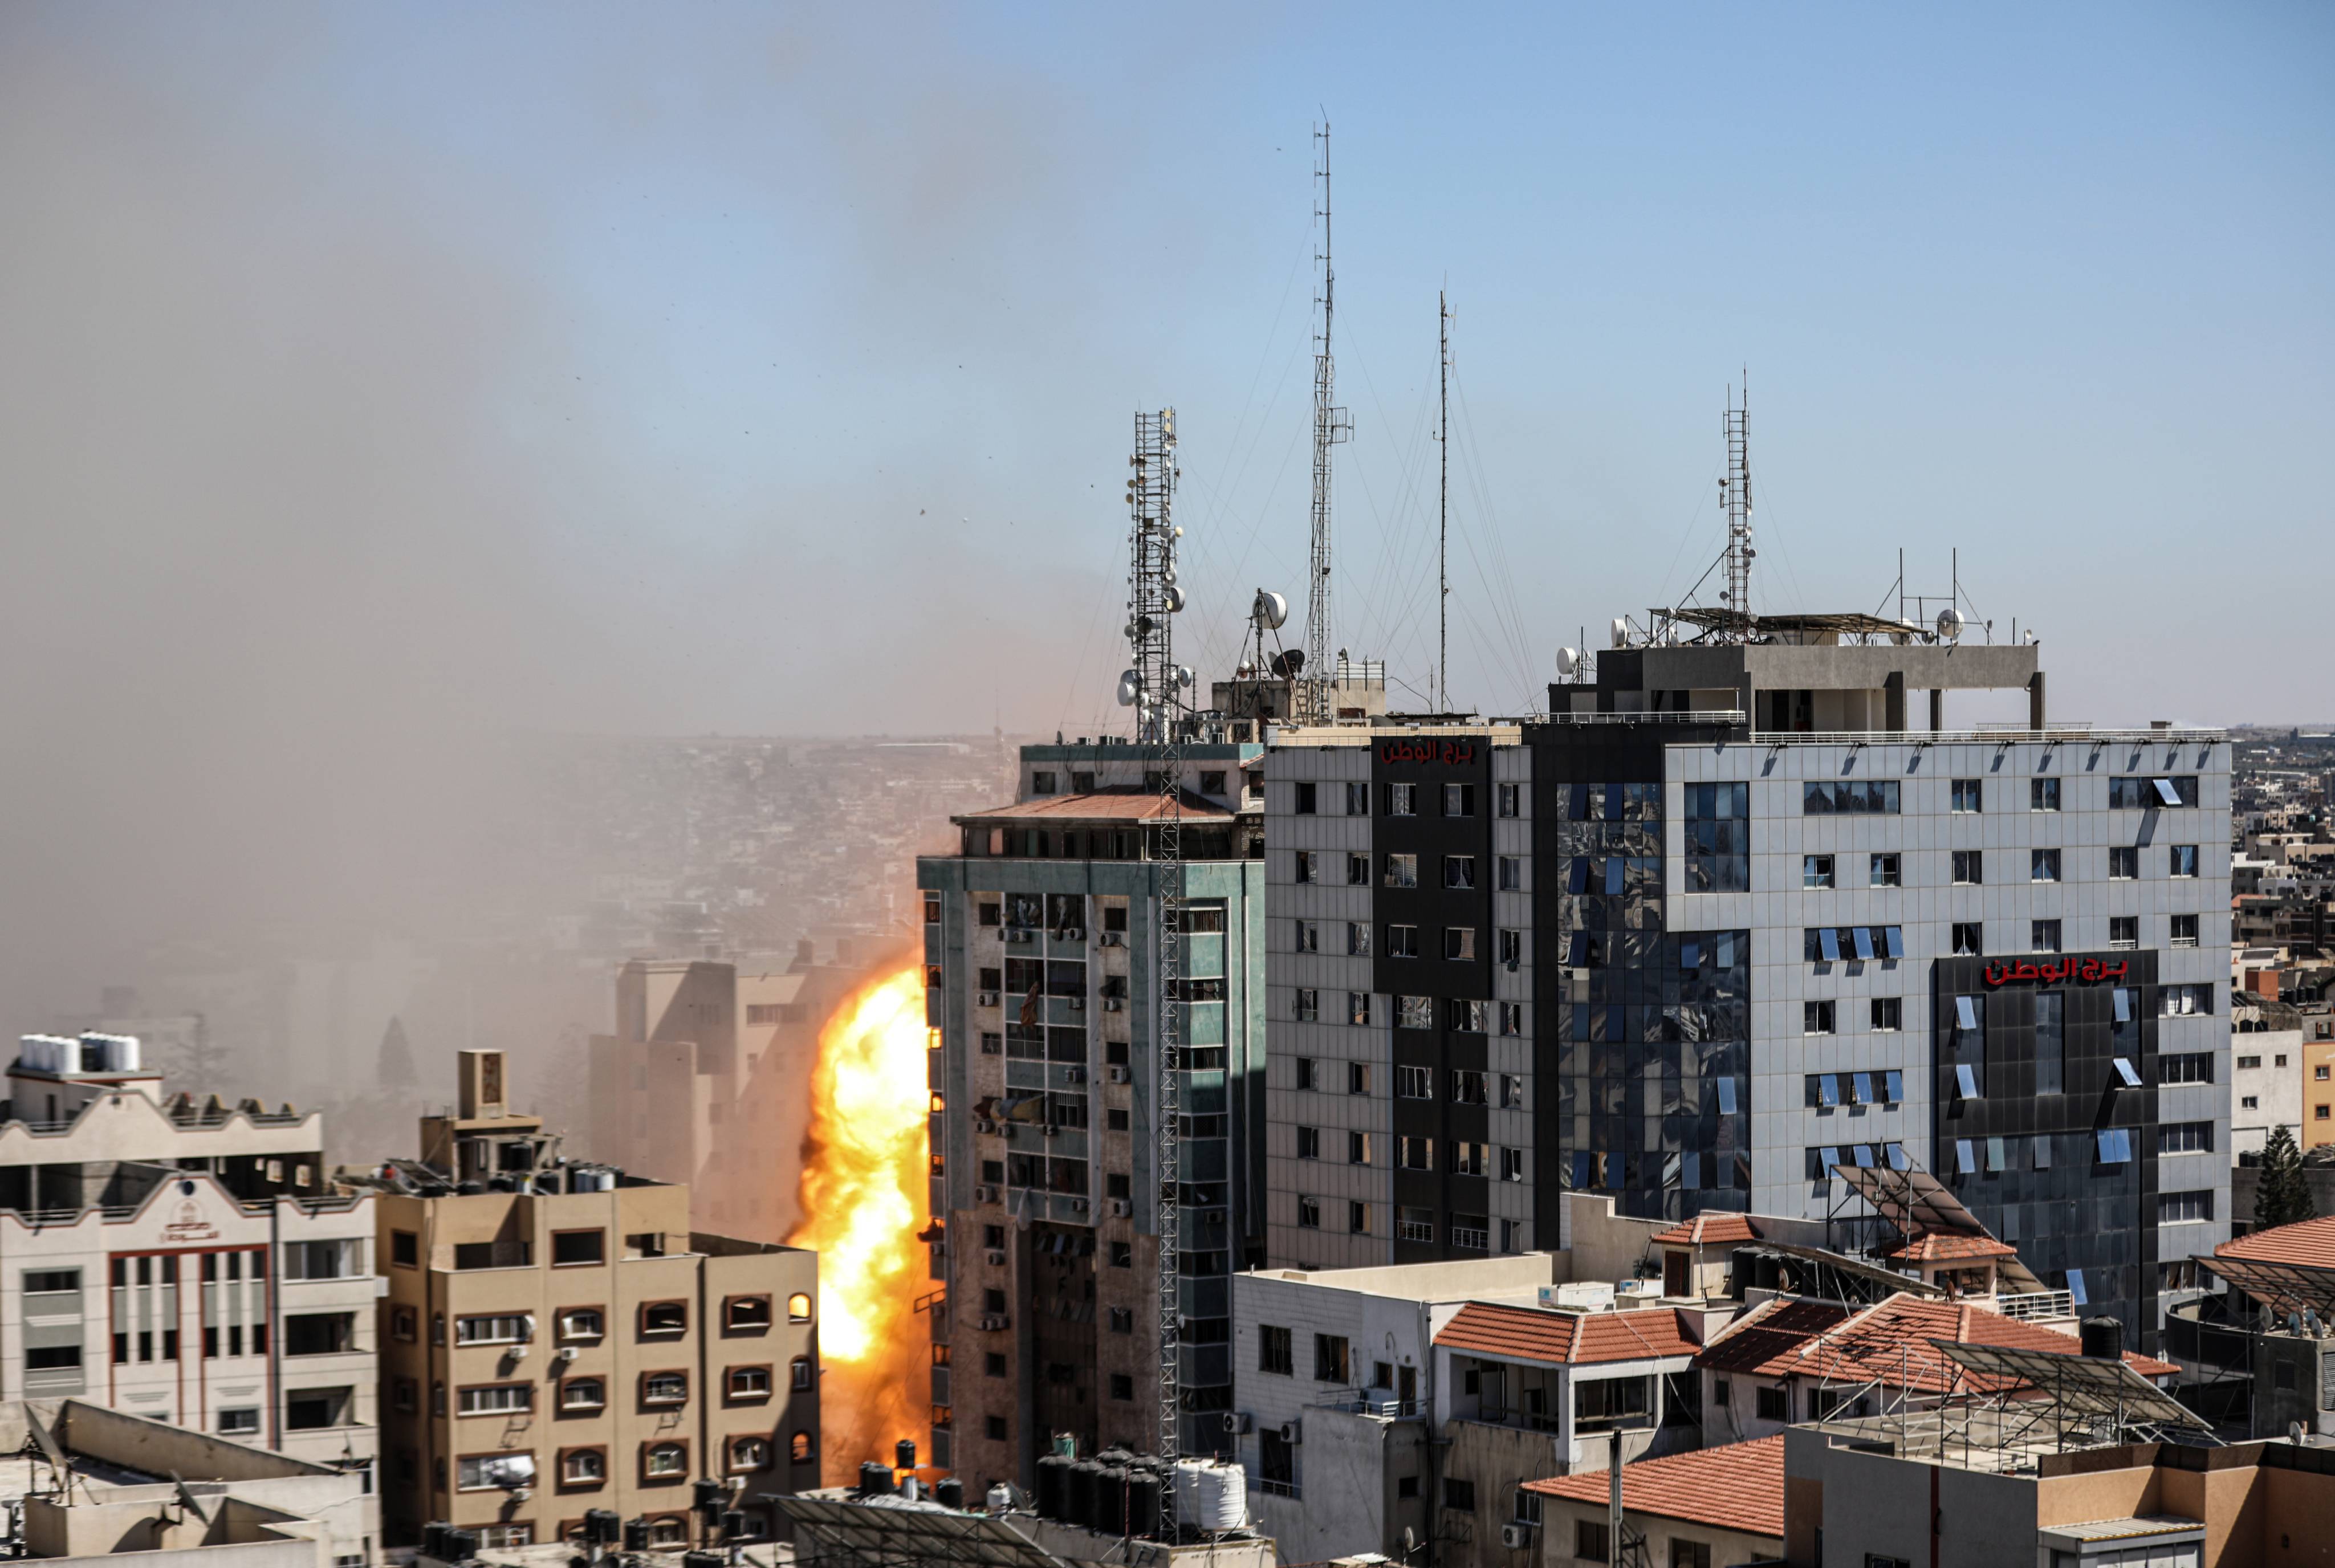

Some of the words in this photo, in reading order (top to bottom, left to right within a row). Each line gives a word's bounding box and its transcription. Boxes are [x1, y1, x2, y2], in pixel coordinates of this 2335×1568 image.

[1380, 741, 1437, 764] الوطن
[1443, 742, 1472, 765] برج
[1986, 958, 2077, 985] الوطن
[2081, 958, 2127, 980] برج
